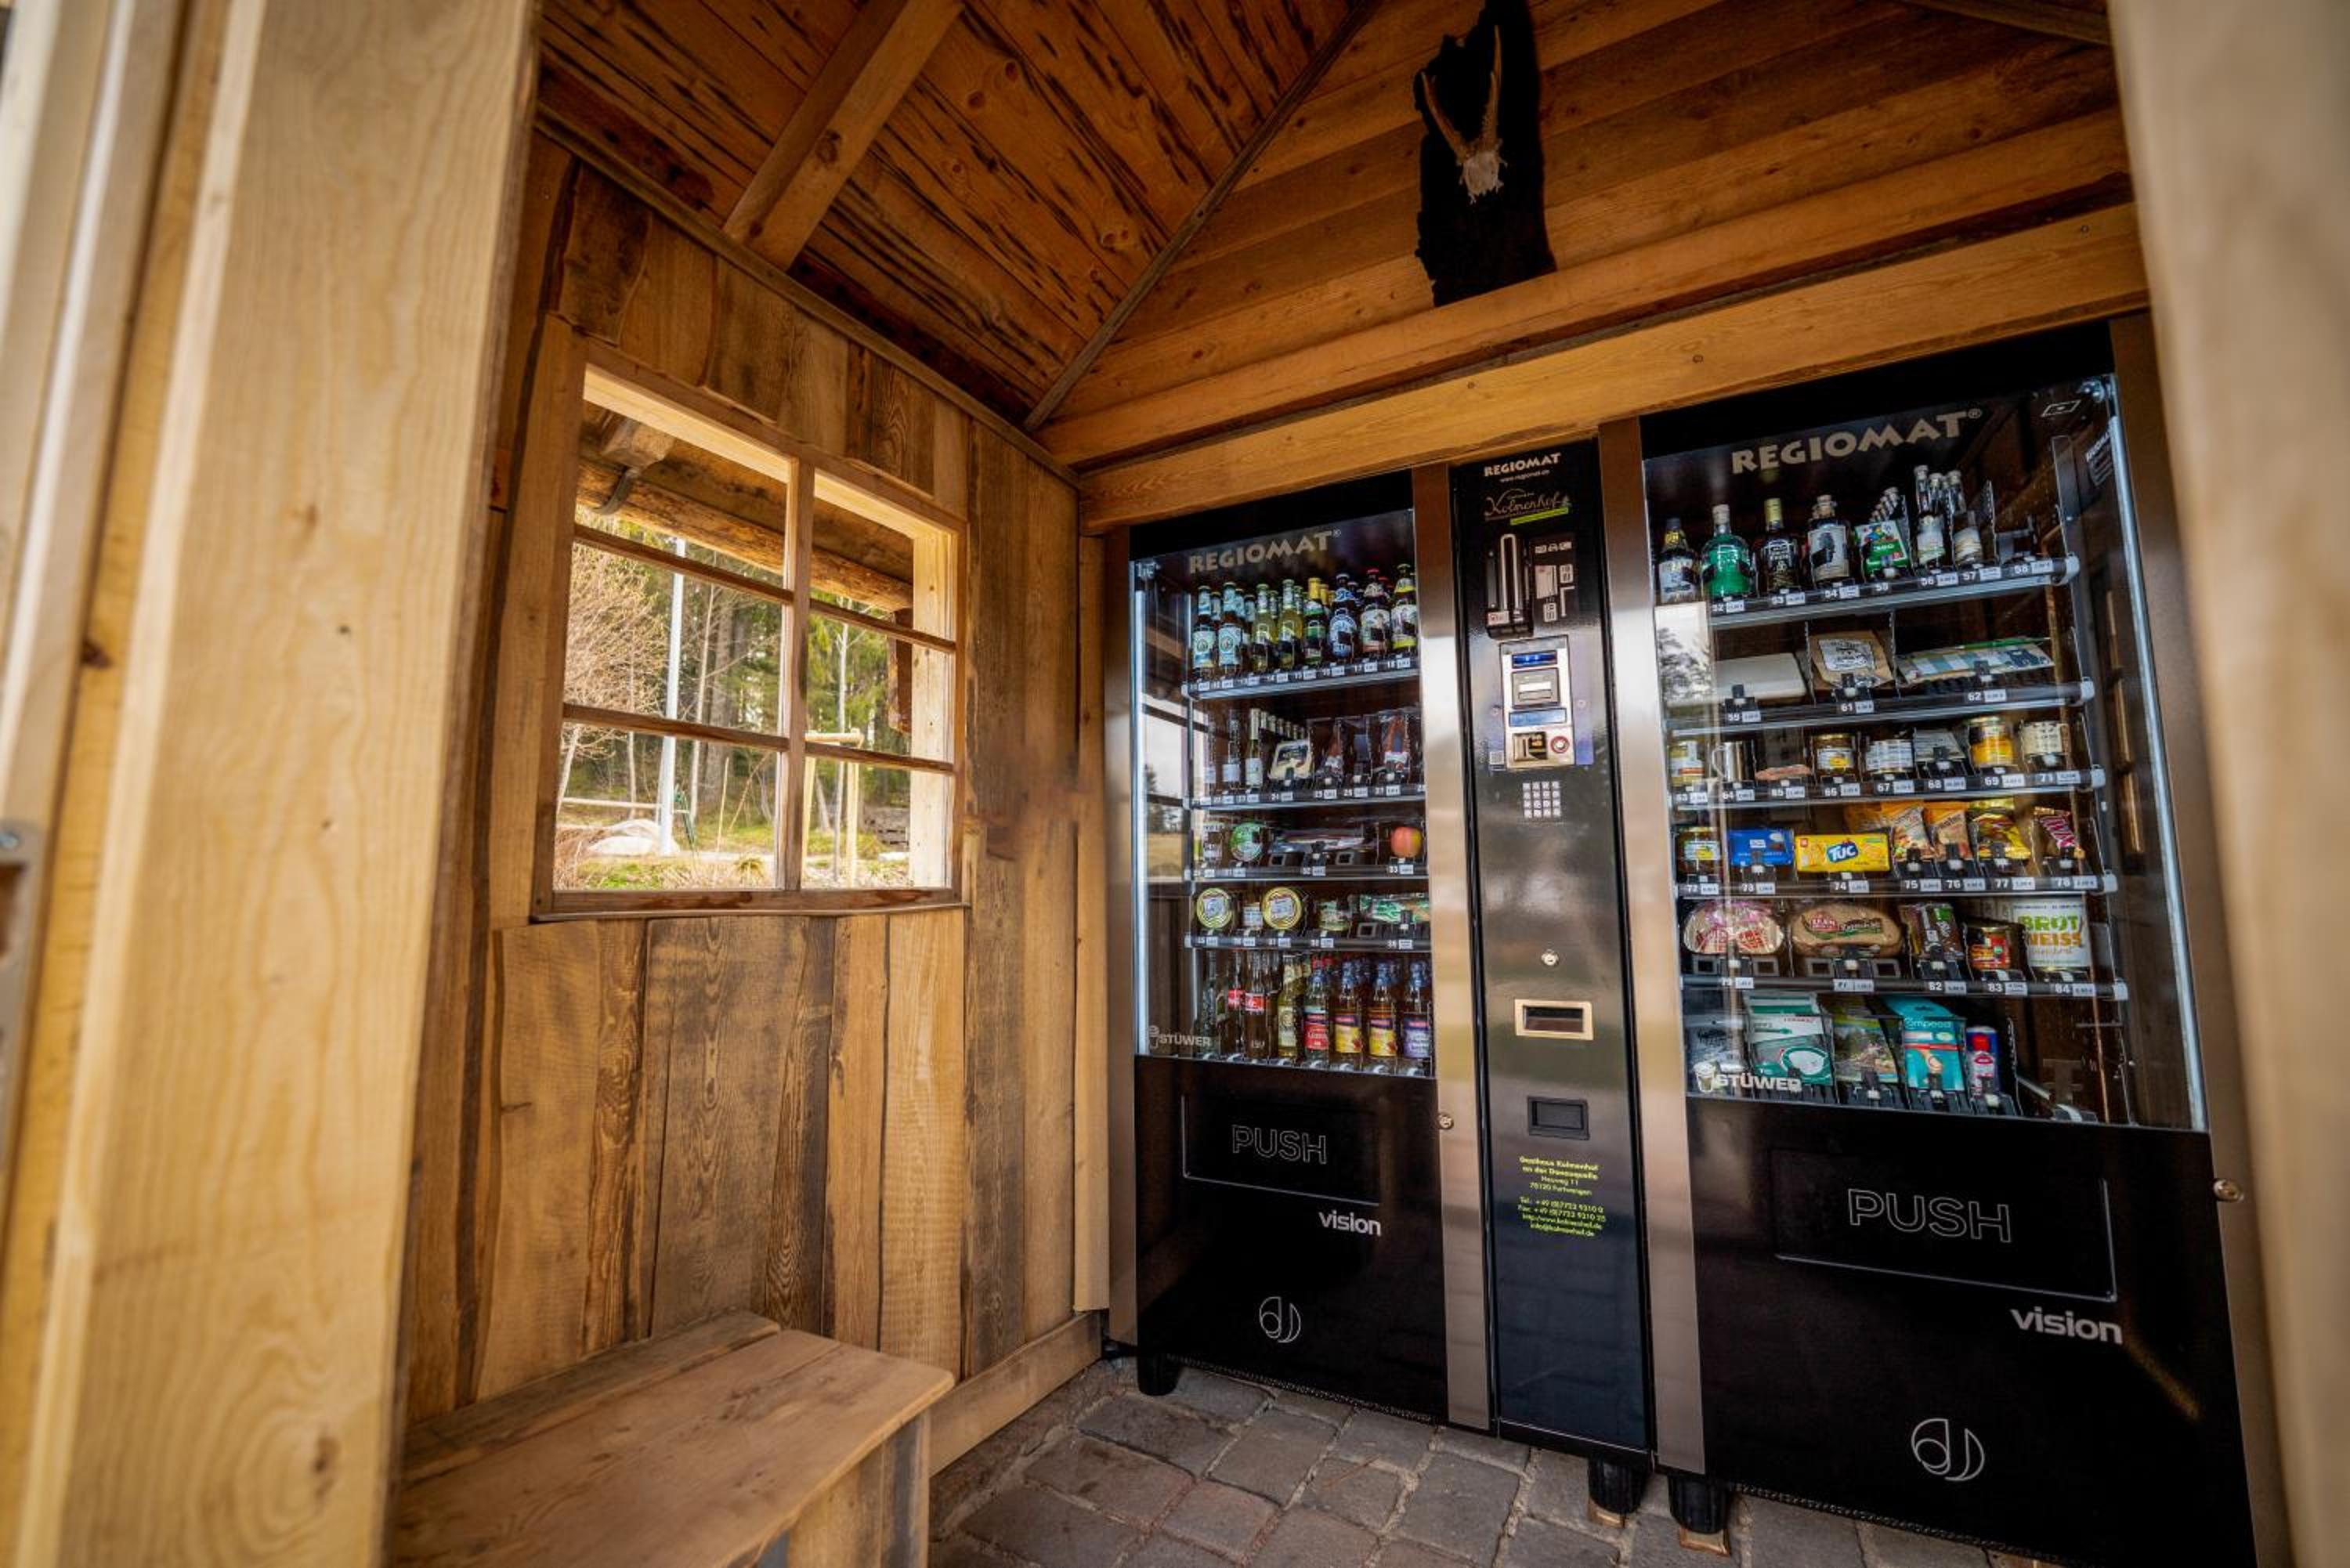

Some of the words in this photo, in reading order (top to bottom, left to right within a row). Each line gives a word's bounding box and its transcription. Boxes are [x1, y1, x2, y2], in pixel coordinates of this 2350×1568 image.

[1484, 452, 1561, 477] REGIOMAT
[1968, 692, 1981, 701] 62
[1828, 845, 1857, 862] TUC
[1834, 882, 1846, 891] 74
[1905, 880, 1918, 890] 75
[1947, 880, 1961, 889] 76
[1995, 878, 2009, 888] 77
[1716, 1072, 1802, 1093] STÜWER
[1231, 1124, 1328, 1165] PUSH
[1318, 1210, 1382, 1237] vision
[1848, 1188, 2012, 1243] PUSH
[2011, 1306, 2124, 1345] vision
